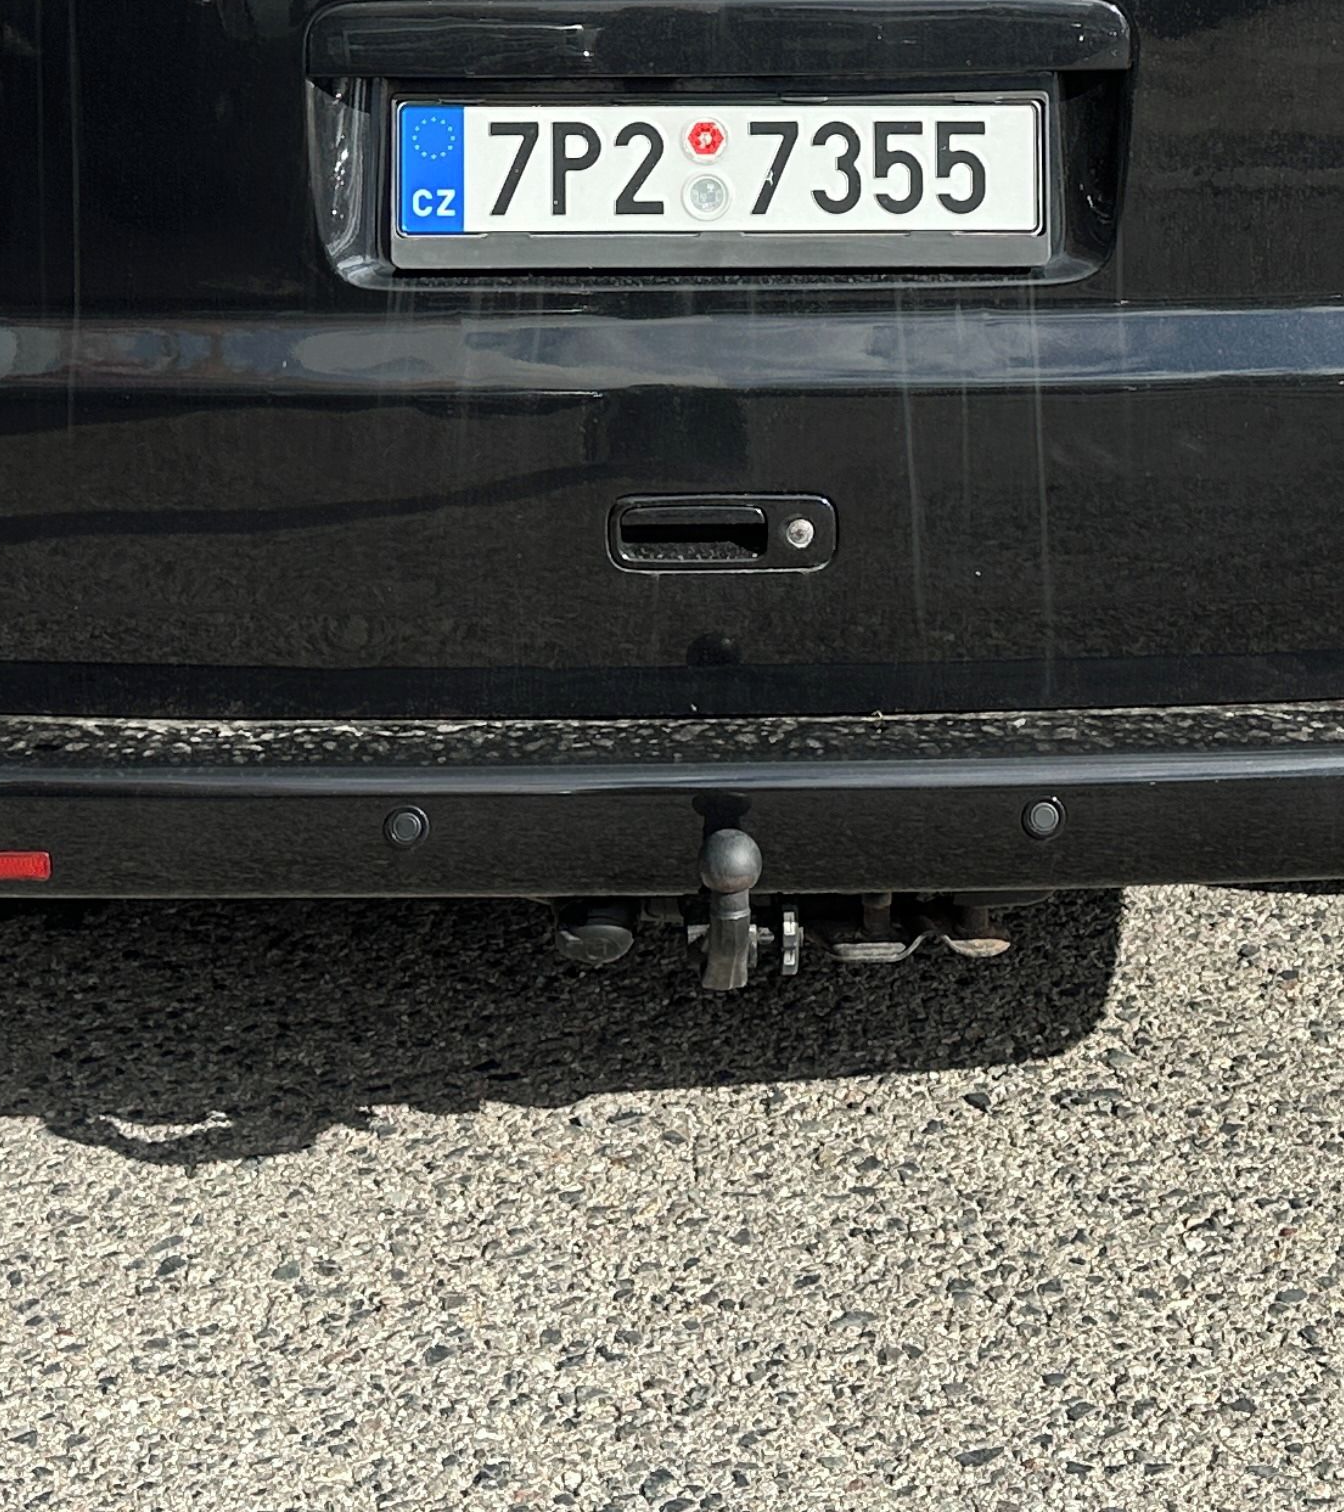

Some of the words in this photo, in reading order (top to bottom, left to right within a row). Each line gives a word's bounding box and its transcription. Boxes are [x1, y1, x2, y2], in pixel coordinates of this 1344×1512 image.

[488, 121, 665, 216] 7P2
[748, 120, 987, 216] 7355
[411, 189, 457, 218] CZ
